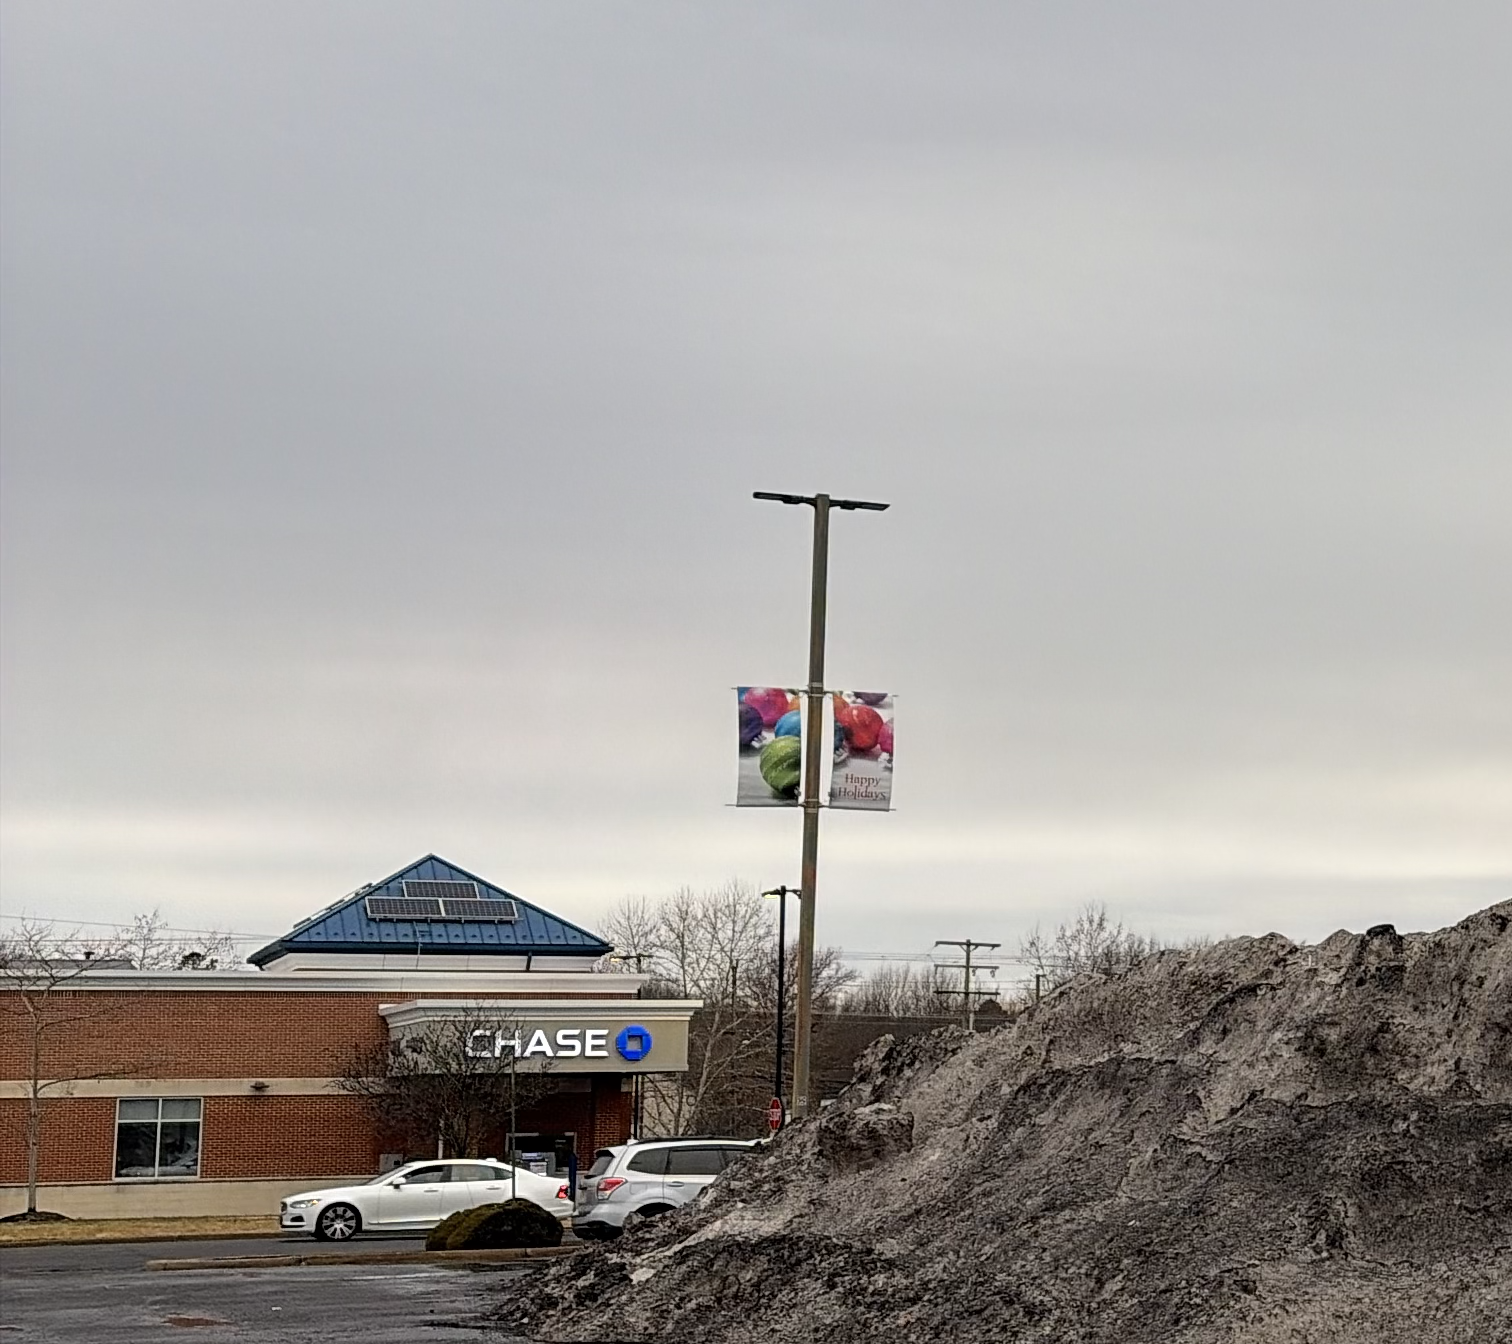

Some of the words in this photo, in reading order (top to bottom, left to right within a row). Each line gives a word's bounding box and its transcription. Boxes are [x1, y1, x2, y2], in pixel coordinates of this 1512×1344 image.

[845, 773, 881, 787] Happy
[838, 785, 886, 800] Holidays
[465, 1029, 609, 1057] CHASE
